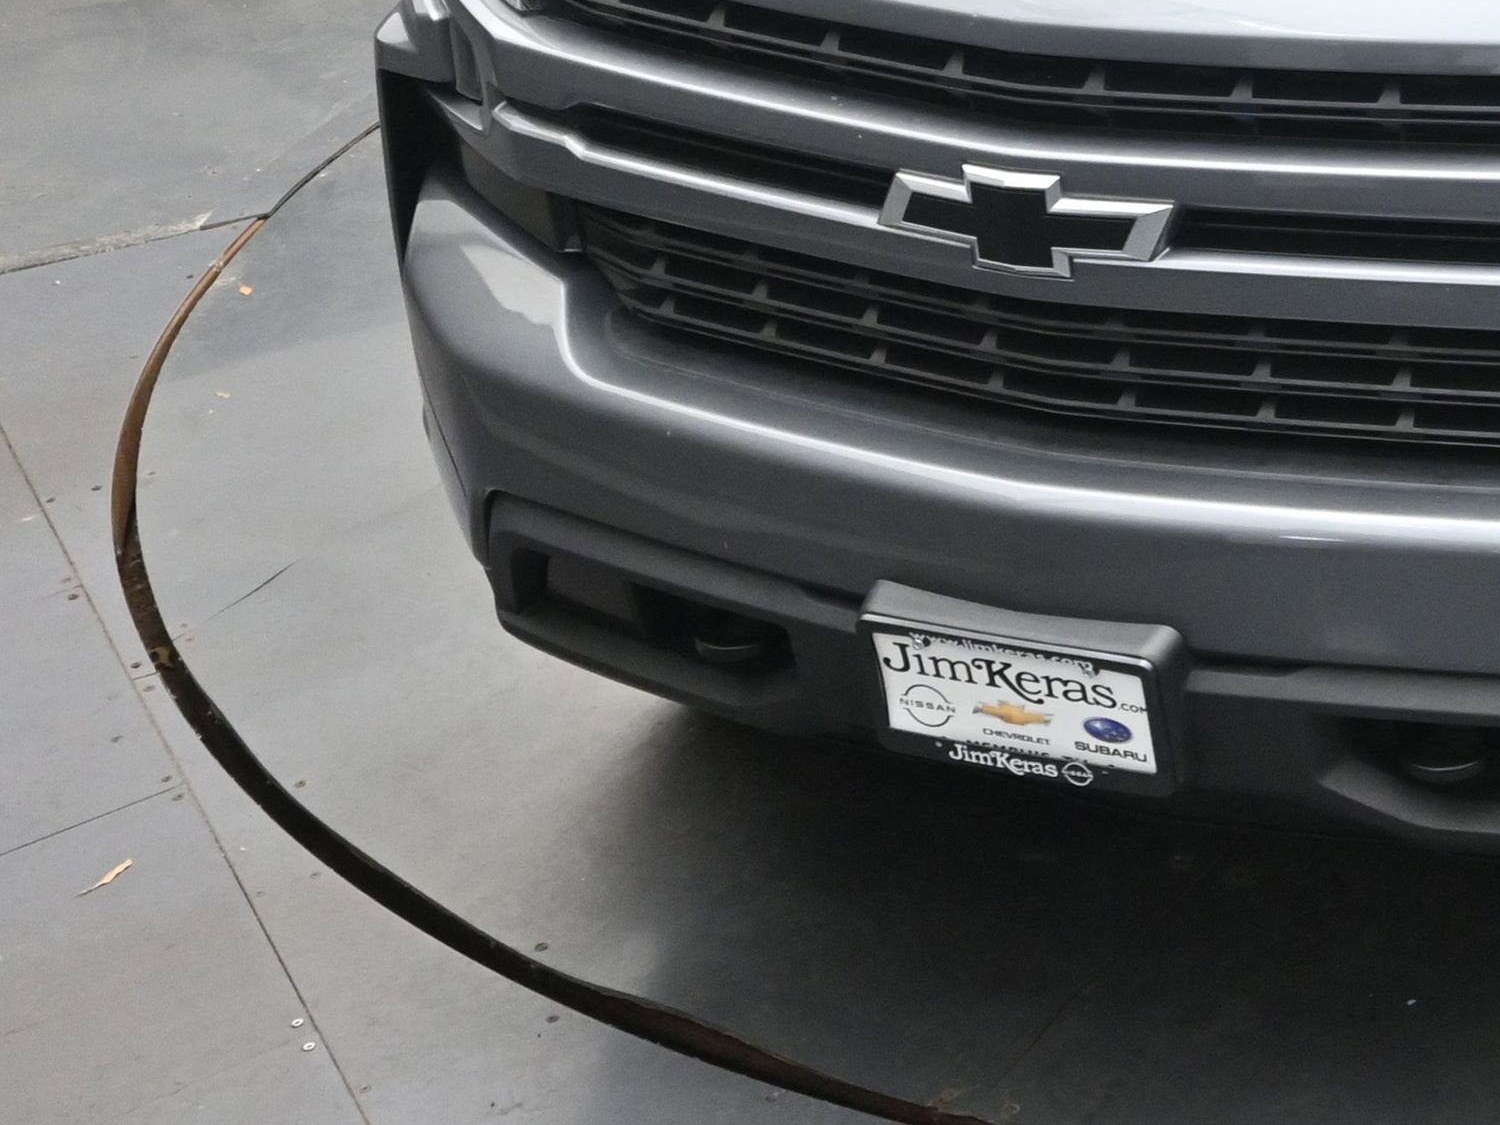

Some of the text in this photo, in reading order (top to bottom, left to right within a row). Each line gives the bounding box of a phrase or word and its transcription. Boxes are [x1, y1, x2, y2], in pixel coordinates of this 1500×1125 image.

[900, 698, 955, 713] NISSAN
[982, 728, 1050, 745] CHEVROLET
[949, 743, 1058, 777] JimKeras
[1074, 741, 1147, 762] SUBARU
